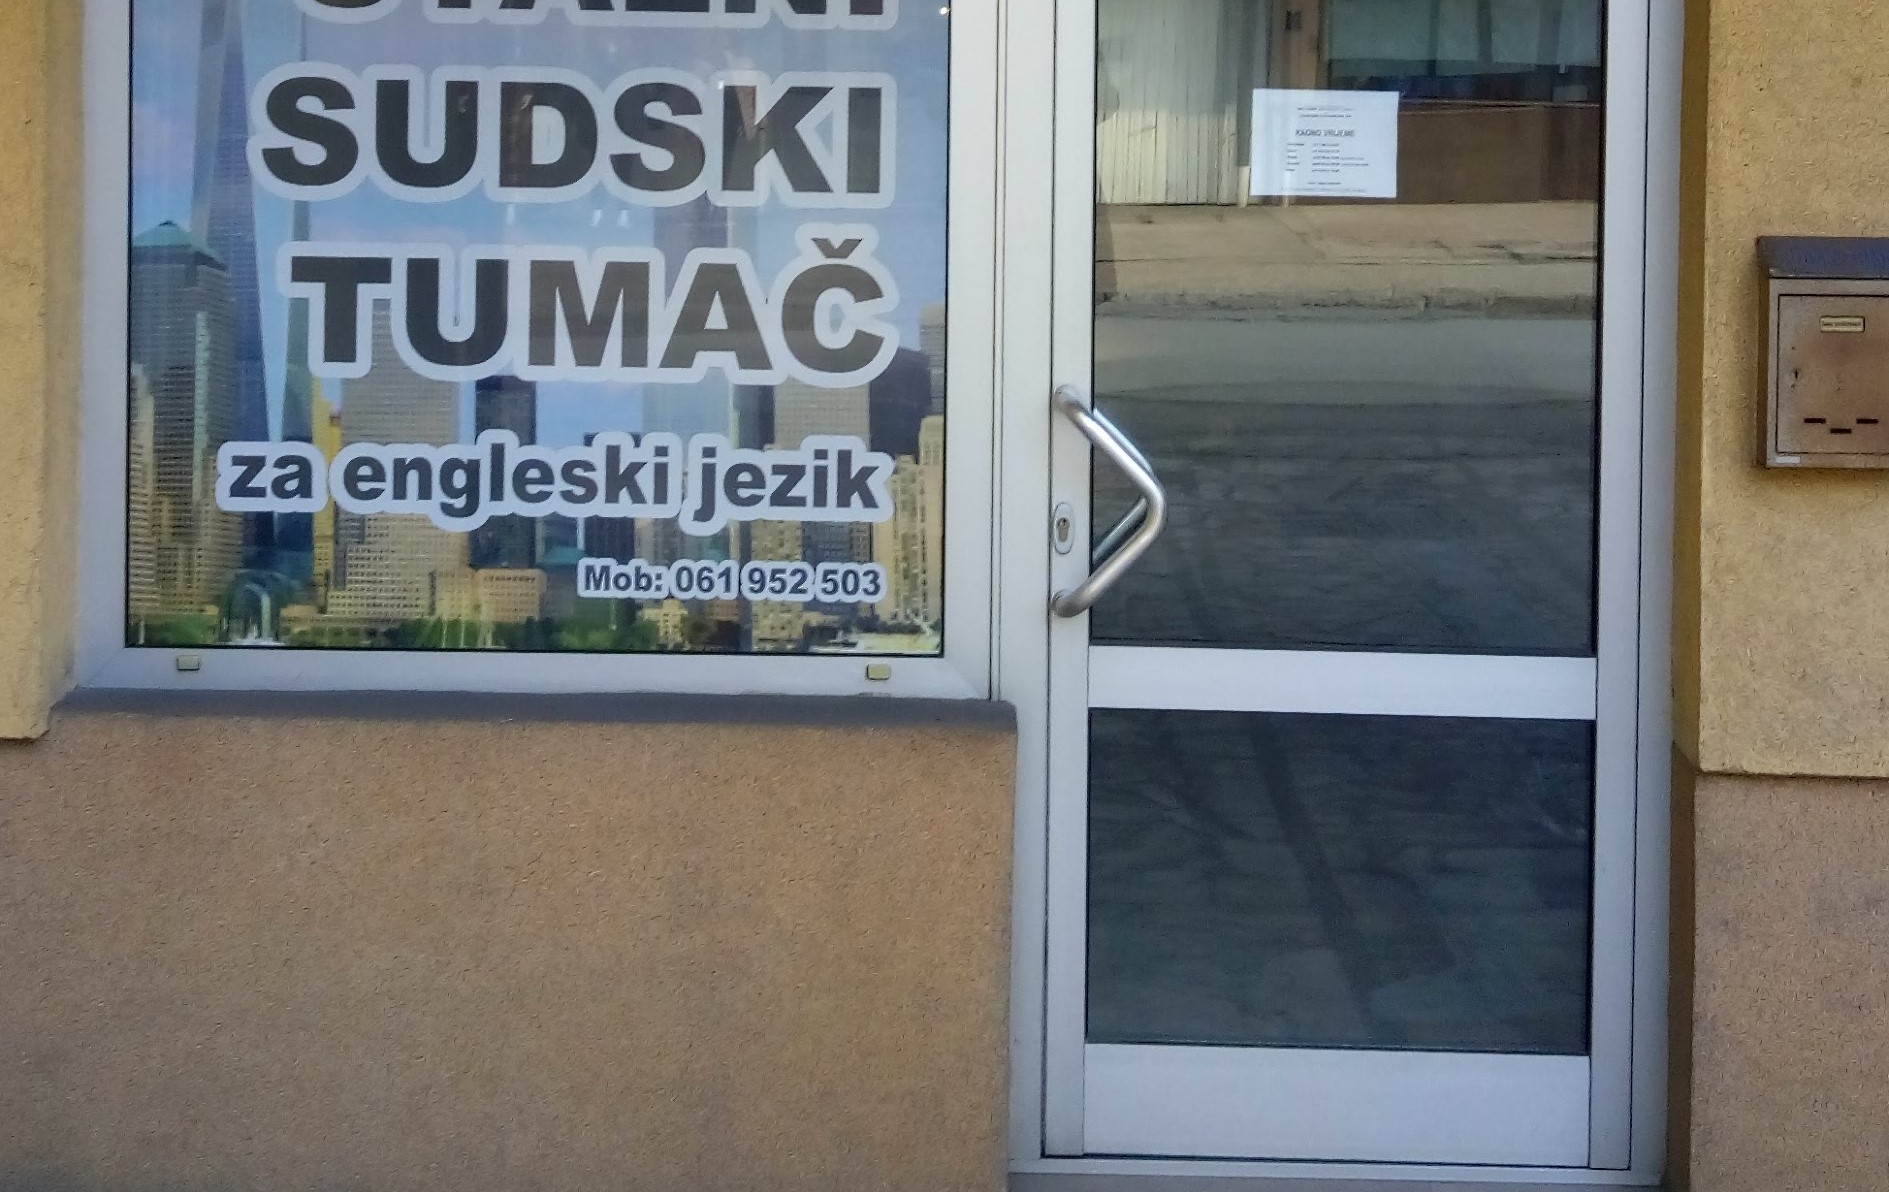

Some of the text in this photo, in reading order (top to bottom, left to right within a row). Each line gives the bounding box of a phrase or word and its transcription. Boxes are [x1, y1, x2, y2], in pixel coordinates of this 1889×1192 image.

[261, 75, 882, 195] SUDSKI
[290, 237, 886, 374] TUMAČ
[228, 443, 881, 524] za engleski jezik
[584, 564, 881, 596] Mob: 061 952 503
